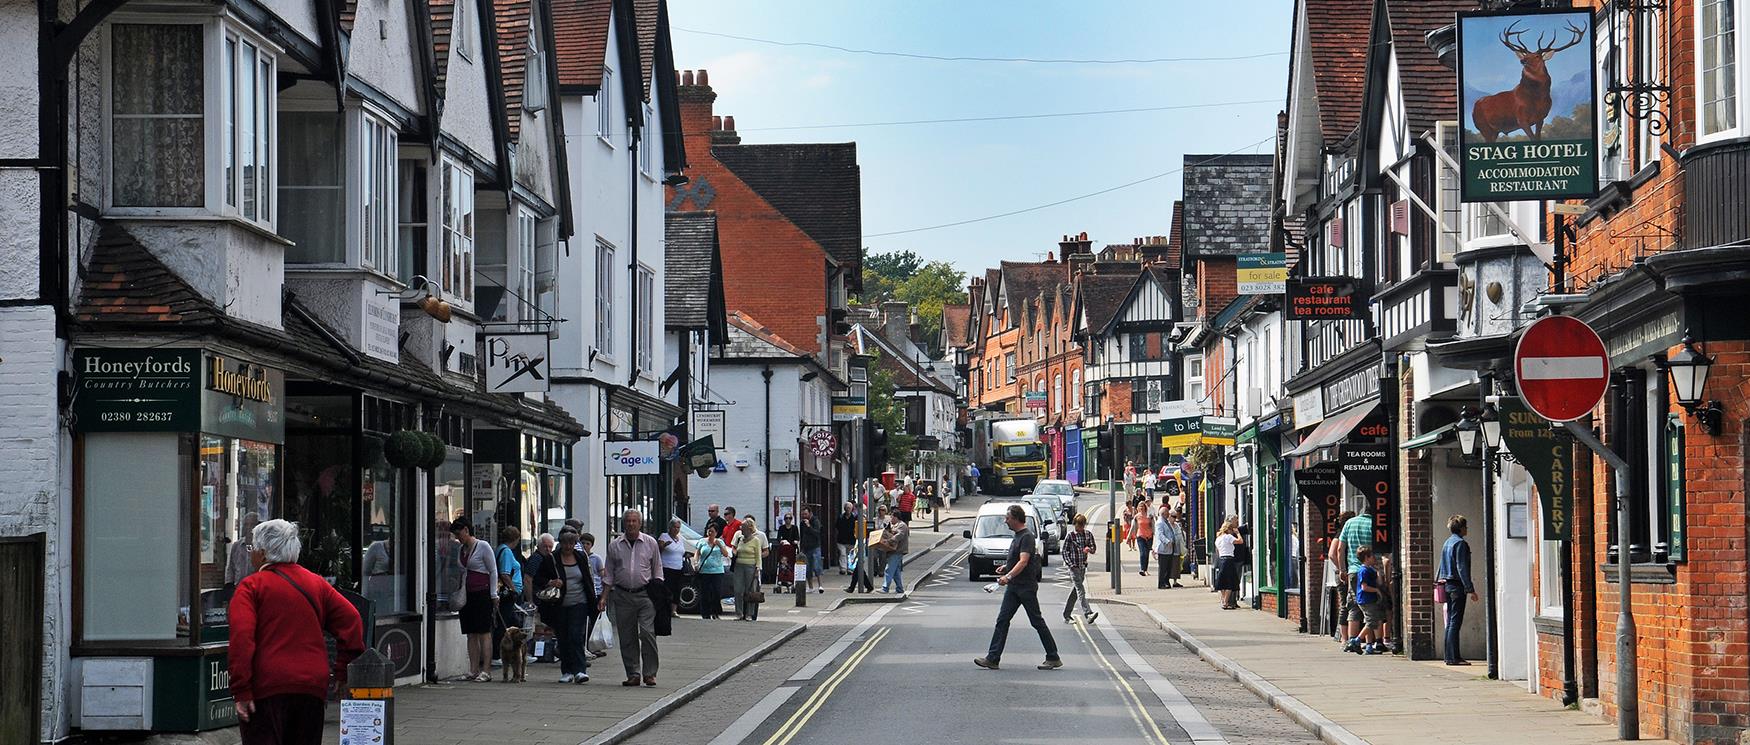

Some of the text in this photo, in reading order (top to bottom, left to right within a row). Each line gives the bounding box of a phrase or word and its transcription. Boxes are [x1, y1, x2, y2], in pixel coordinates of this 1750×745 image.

[1469, 144, 1588, 160] STAG HOTEL
[1477, 166, 1580, 179] ACCOMMODATION
[1490, 180, 1568, 192] RESTAURANT
[1249, 271, 1281, 280] for sale
[1310, 284, 1334, 294] cafe
[1293, 295, 1351, 305] restaurant
[1294, 306, 1351, 315] tea rooms
[84, 356, 191, 379] Honeyfords
[84, 379, 191, 390] Country Butchers
[212, 355, 273, 412] Honeyfords
[101, 412, 173, 421] 02380 282637
[1174, 420, 1200, 432] to let
[1360, 424, 1389, 436] cafe
[813, 432, 832, 440] COSTA
[1508, 428, 1533, 438] From
[812, 447, 834, 456] COFFEE
[621, 457, 641, 467] age
[1551, 445, 1565, 534] CARVERY
[1375, 481, 1388, 542] OPEN
